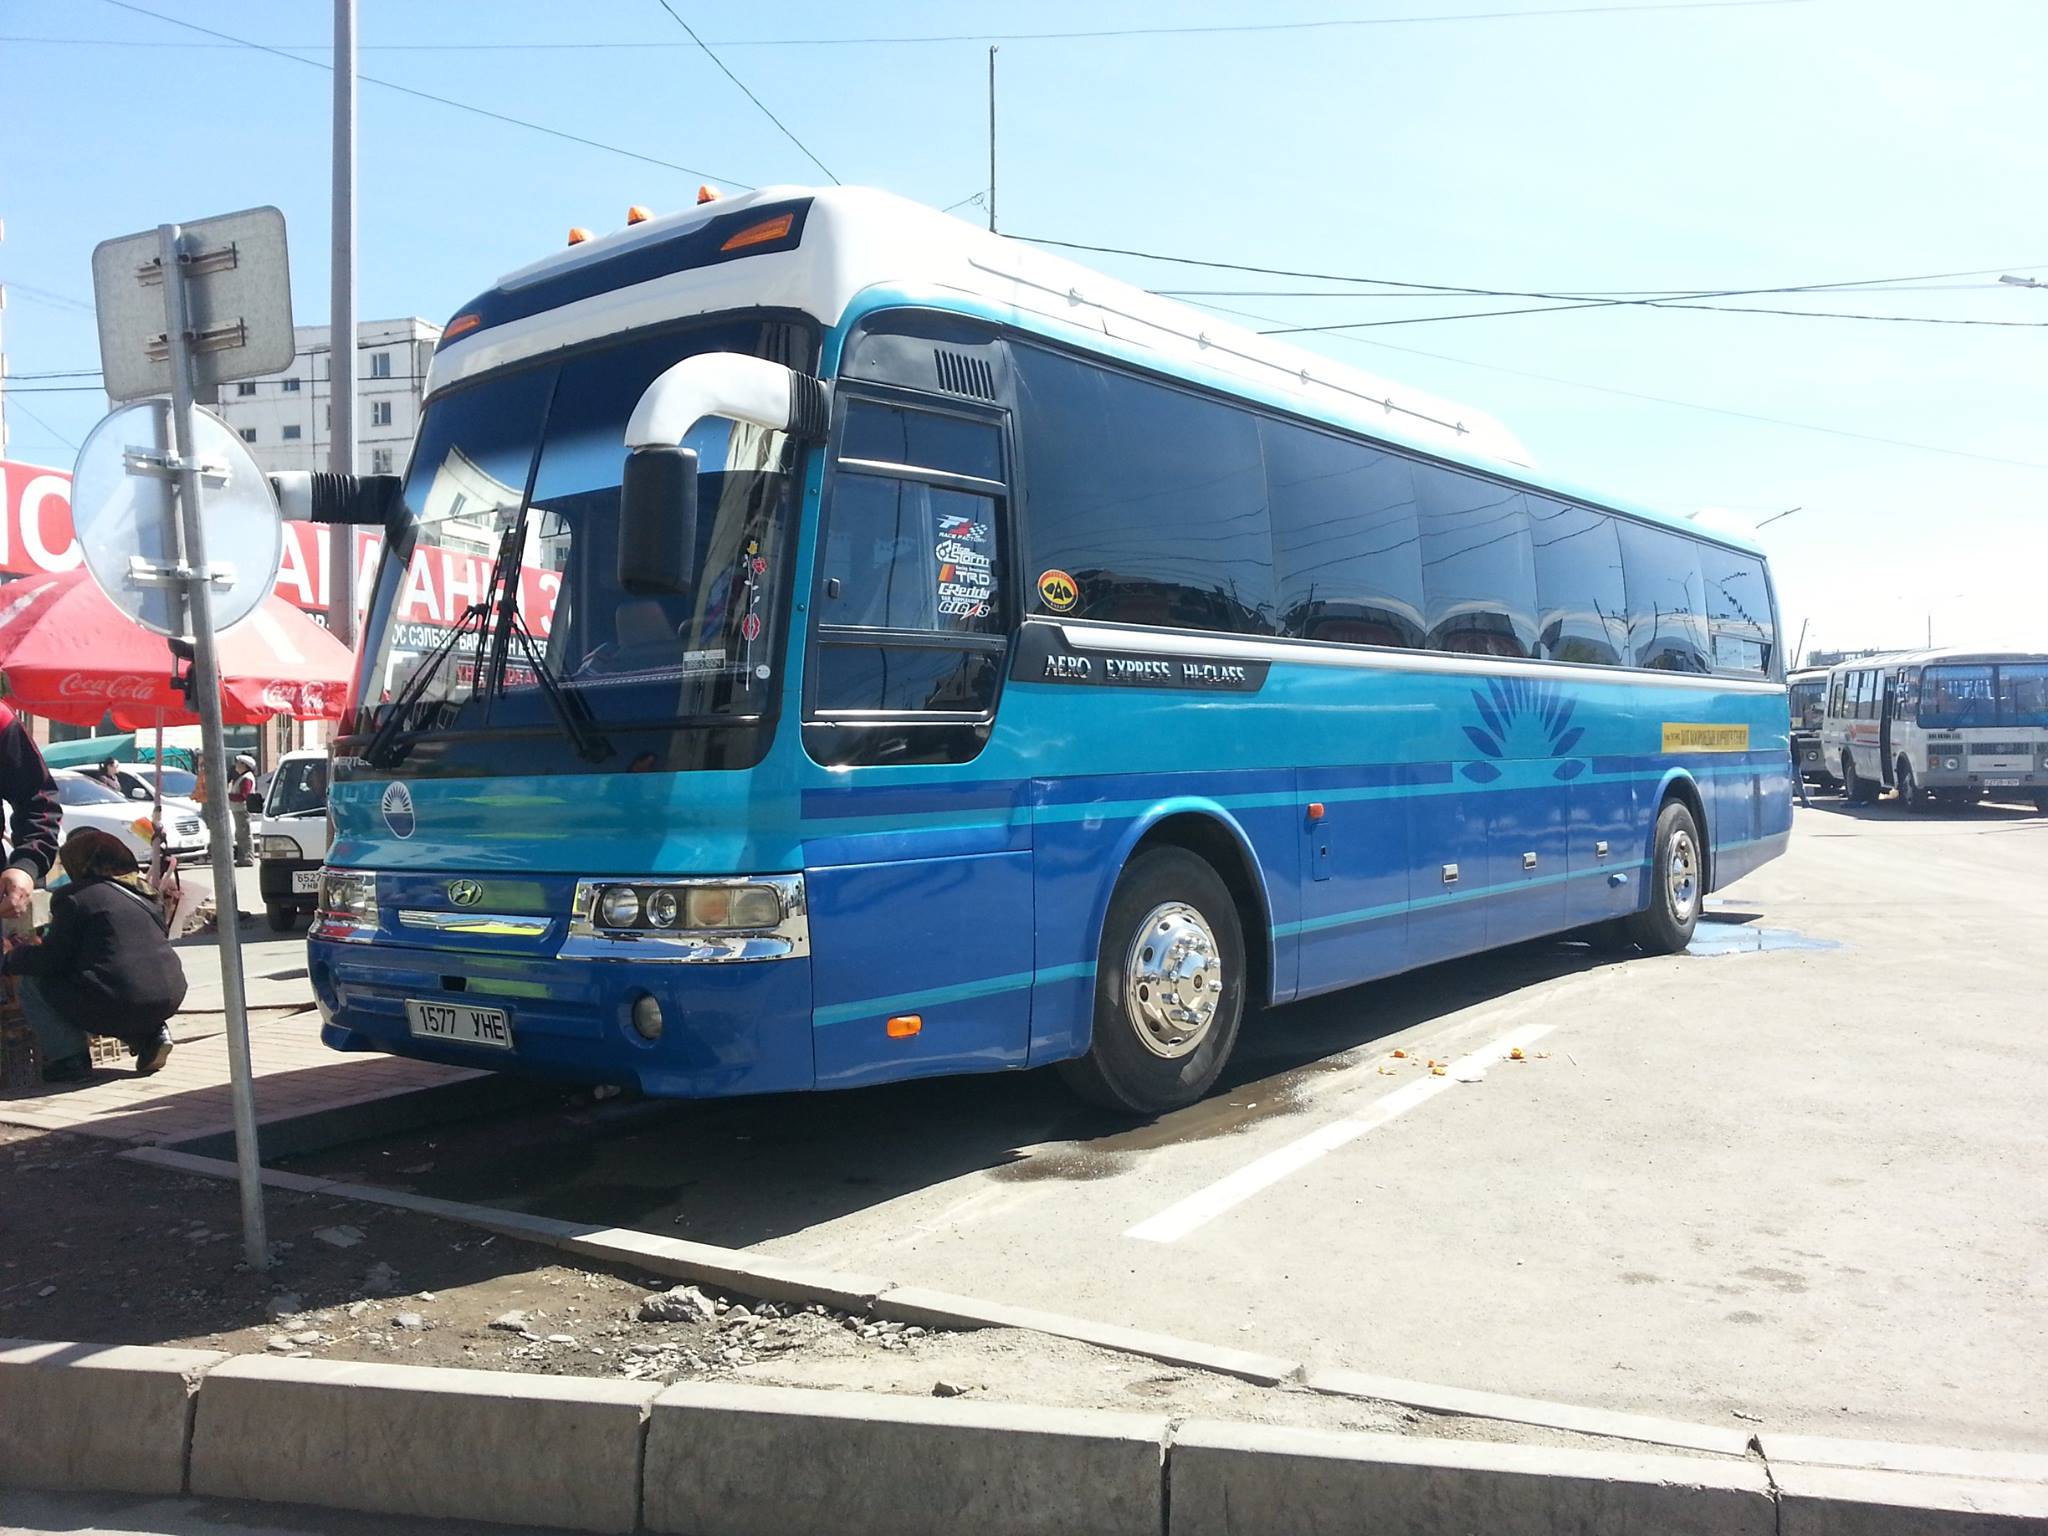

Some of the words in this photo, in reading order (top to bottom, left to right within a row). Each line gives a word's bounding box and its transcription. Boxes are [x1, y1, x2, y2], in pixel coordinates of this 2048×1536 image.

[955, 571, 990, 586] TRD
[1044, 655, 1092, 679] AERO
[1105, 659, 1172, 681] EXPRESS
[1183, 663, 1246, 684] HI-CLASS
[420, 1006, 456, 1034] 1577
